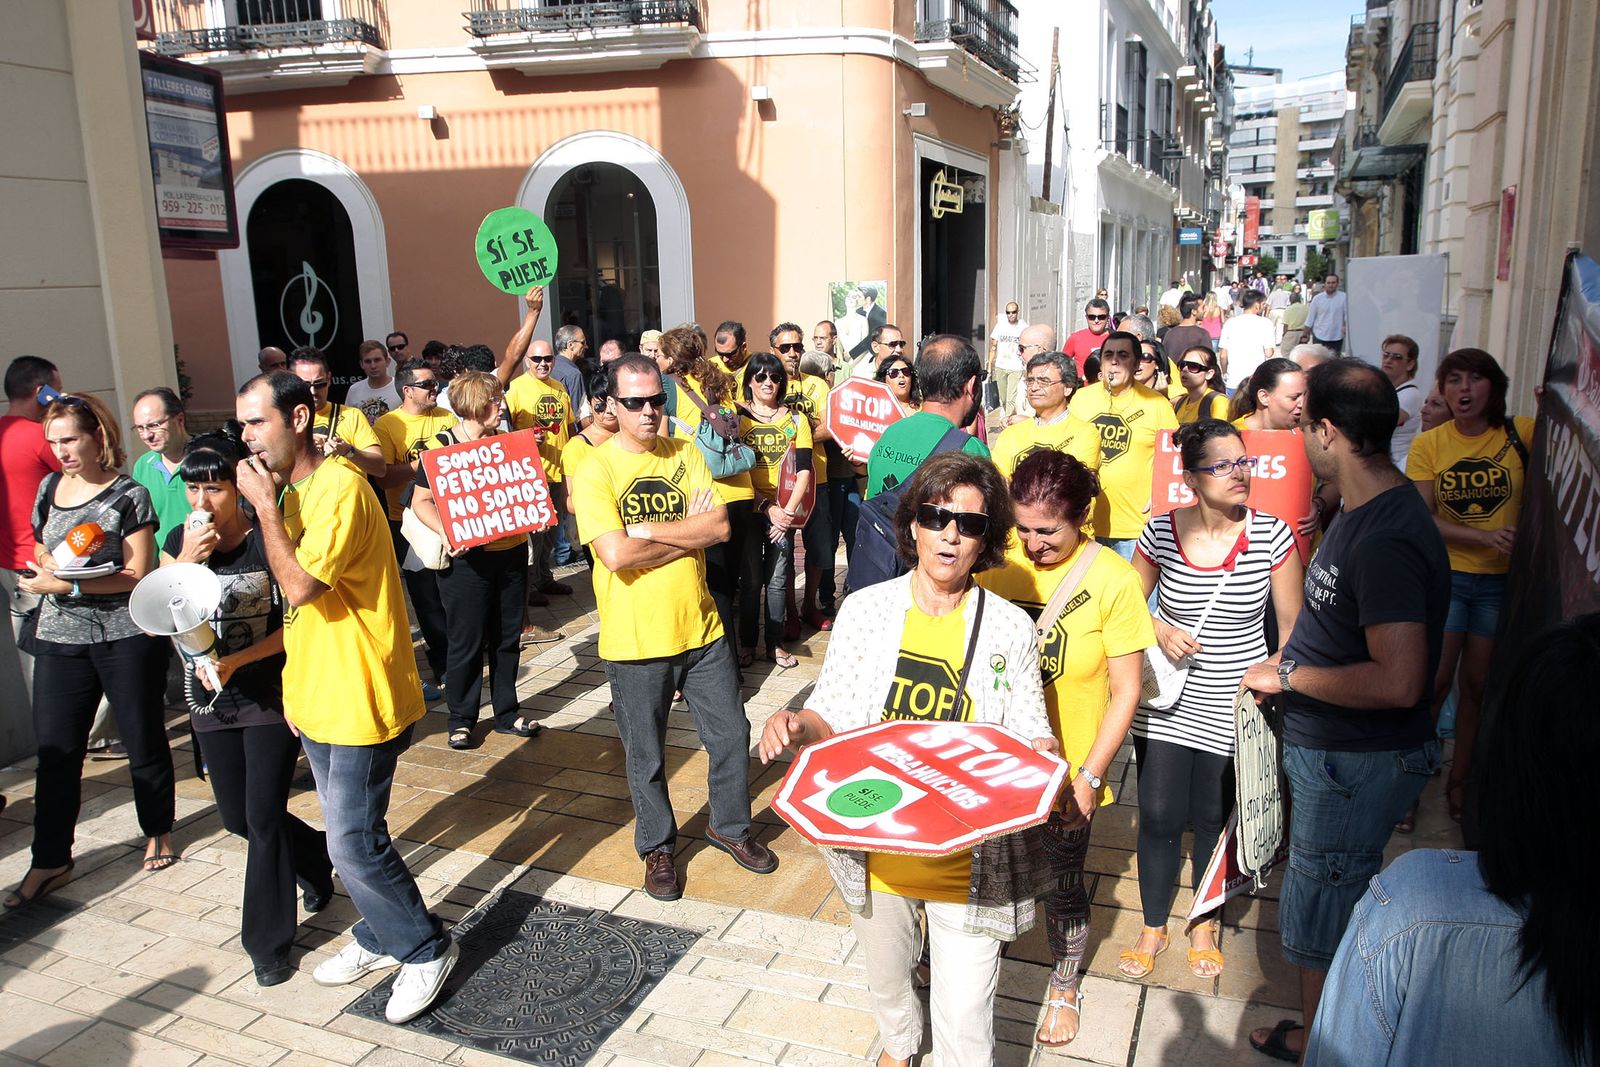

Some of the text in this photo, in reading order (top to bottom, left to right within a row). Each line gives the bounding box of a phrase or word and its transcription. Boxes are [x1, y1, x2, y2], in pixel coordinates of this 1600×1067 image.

[147, 76, 212, 100] TALLERES FLORES
[162, 200, 180, 212] 959
[187, 201, 203, 214] 225
[210, 203, 226, 215] 012
[486, 229, 539, 264] SÍ SE
[498, 257, 553, 290] PUEDE
[538, 402, 562, 414] STOP
[840, 388, 892, 420] STOP
[744, 433, 785, 447] STOP
[1092, 422, 1127, 441] TOP
[436, 442, 505, 474] SOMOS
[435, 457, 537, 497] PERSONAS
[672, 461, 686, 484] HUELV
[1442, 467, 1502, 490] STOP
[448, 479, 548, 518] NO SOMOS
[626, 491, 680, 515] STOP
[1440, 485, 1508, 501] DESAHUCIOS
[452, 501, 551, 543] NUMEROS
[1060, 593, 1089, 618] HUELVA
[892, 676, 957, 720] TOP
[908, 725, 1050, 789] STOP
[868, 742, 990, 810] DESAHUCIOS
[843, 792, 875, 810] PUEDE
[868, 793, 884, 802] SE
